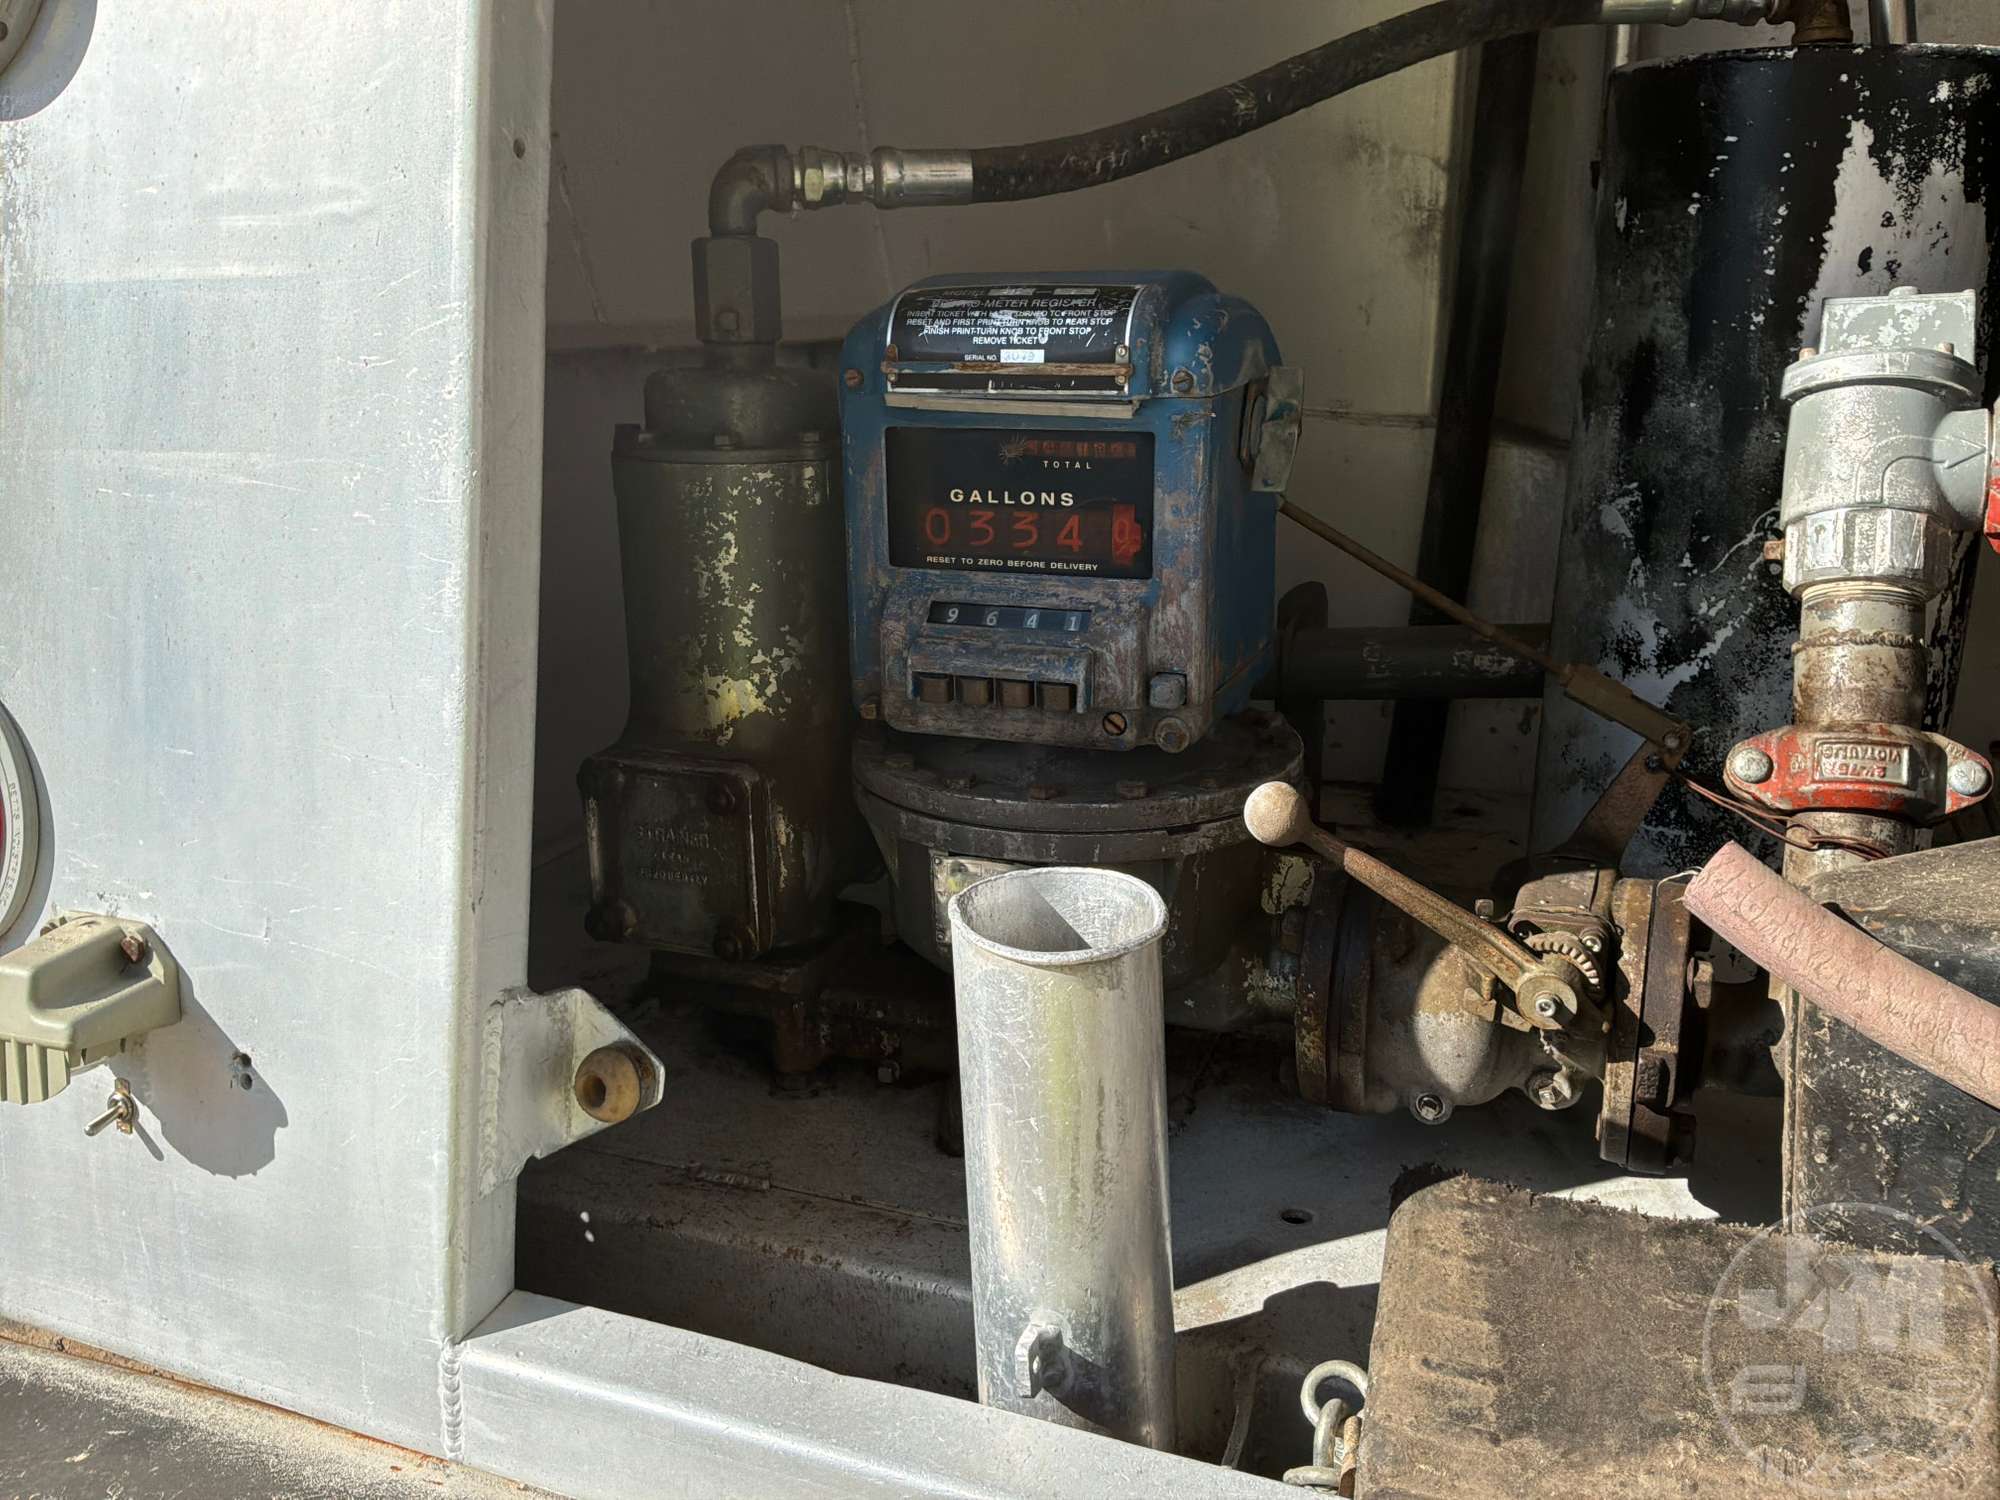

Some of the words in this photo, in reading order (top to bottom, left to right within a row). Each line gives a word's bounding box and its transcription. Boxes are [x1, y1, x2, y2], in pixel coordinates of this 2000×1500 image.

[1031, 299, 1096, 307] REGISER
[906, 318, 931, 326] RESET
[933, 318, 951, 326] AND
[952, 318, 975, 326] FIRST
[1052, 318, 1063, 326] TO
[1065, 318, 1088, 326] REAR
[1090, 318, 1113, 326] STOP
[925, 327, 950, 335] FINISH
[951, 327, 998, 335] PRINT-TURN
[999, 327, 1024, 335] KNOB
[1026, 327, 1037, 335] TO
[1038, 327, 1066, 335] FRONT
[1068, 327, 1092, 335] STOP
[973, 336, 1007, 345] REMOVE
[1009, 336, 1038, 345] TICKET
[1043, 460, 1092, 470] TOTAL
[950, 488, 1075, 507] GALLONS
[926, 556, 956, 565] RESET
[961, 557, 974, 565] TO
[977, 558, 1004, 567] ZERO
[1007, 559, 1046, 569] BEFORE
[1050, 562, 1098, 571] DELIVERY
